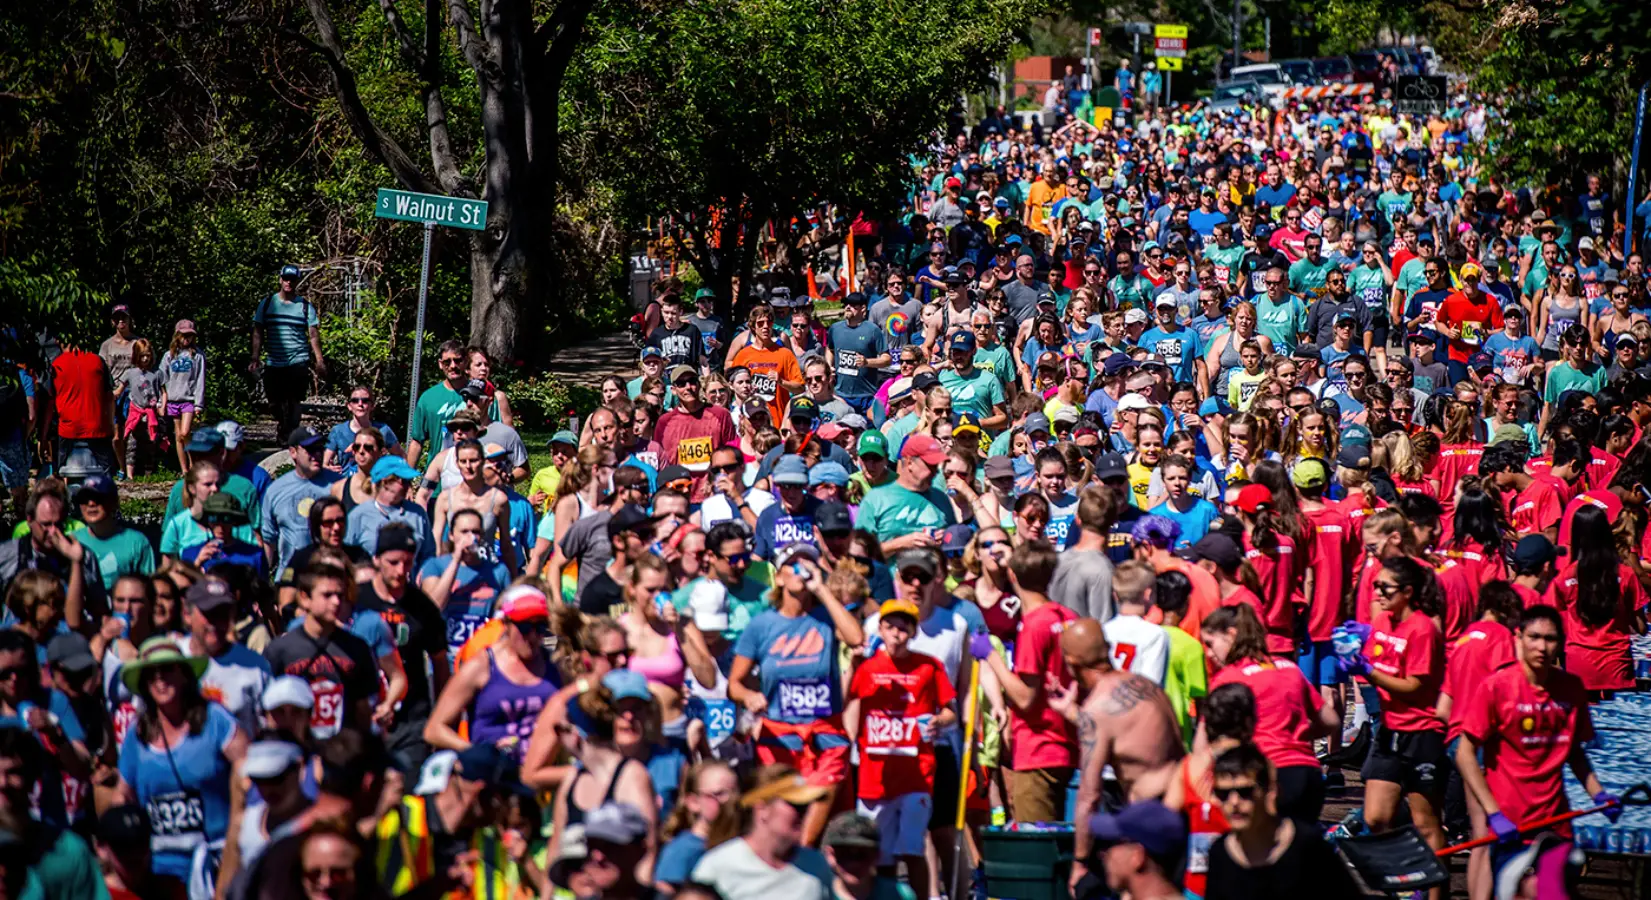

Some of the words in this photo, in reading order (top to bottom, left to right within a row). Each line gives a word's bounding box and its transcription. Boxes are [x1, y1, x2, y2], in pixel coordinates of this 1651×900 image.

[395, 194, 455, 220] Walnut
[460, 203, 481, 225] St
[661, 335, 692, 356] JOCKS
[709, 707, 735, 730] 26
